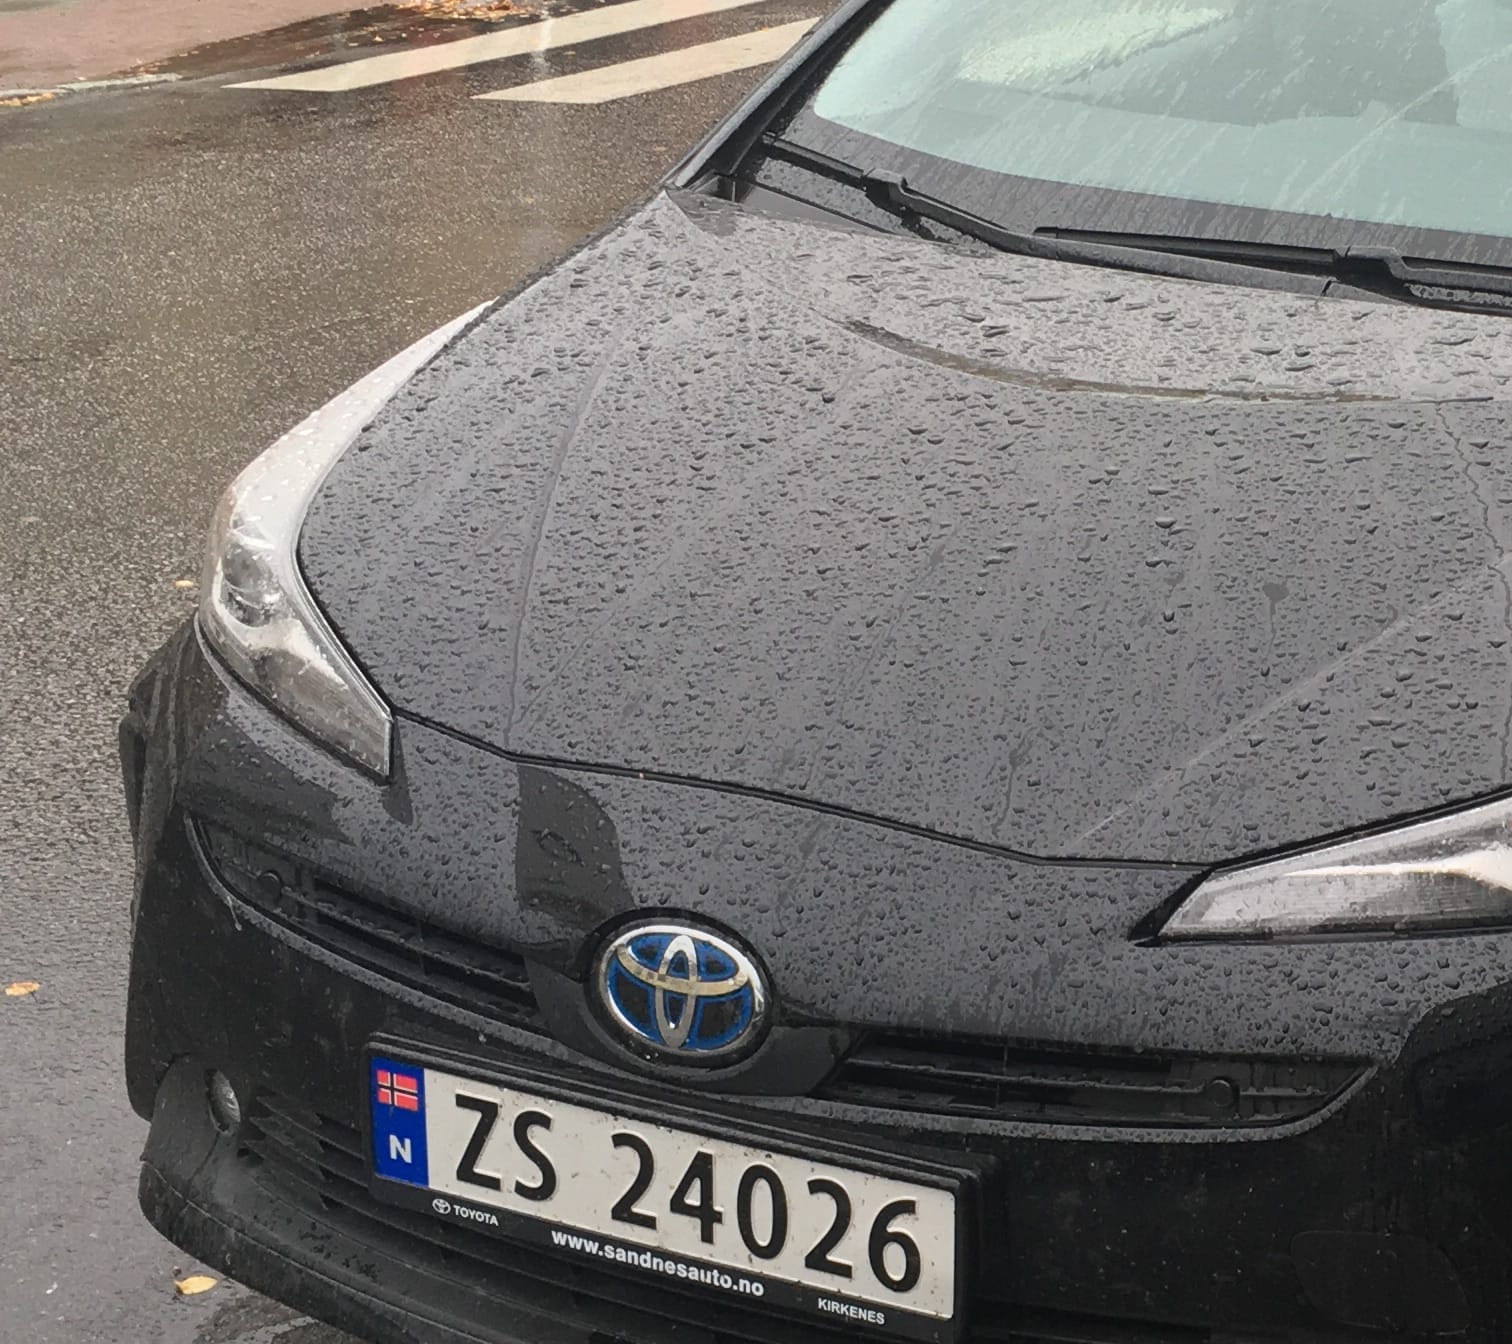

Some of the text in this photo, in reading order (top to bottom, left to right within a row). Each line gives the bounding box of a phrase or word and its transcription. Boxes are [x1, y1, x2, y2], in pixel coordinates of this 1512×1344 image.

[389, 1135, 412, 1164] N
[454, 1091, 922, 1294] ZS 24026
[453, 1204, 499, 1227] TOYOTA
[551, 1230, 765, 1297] www.sandnesauto.no
[817, 1296, 885, 1325] KIRKENES
